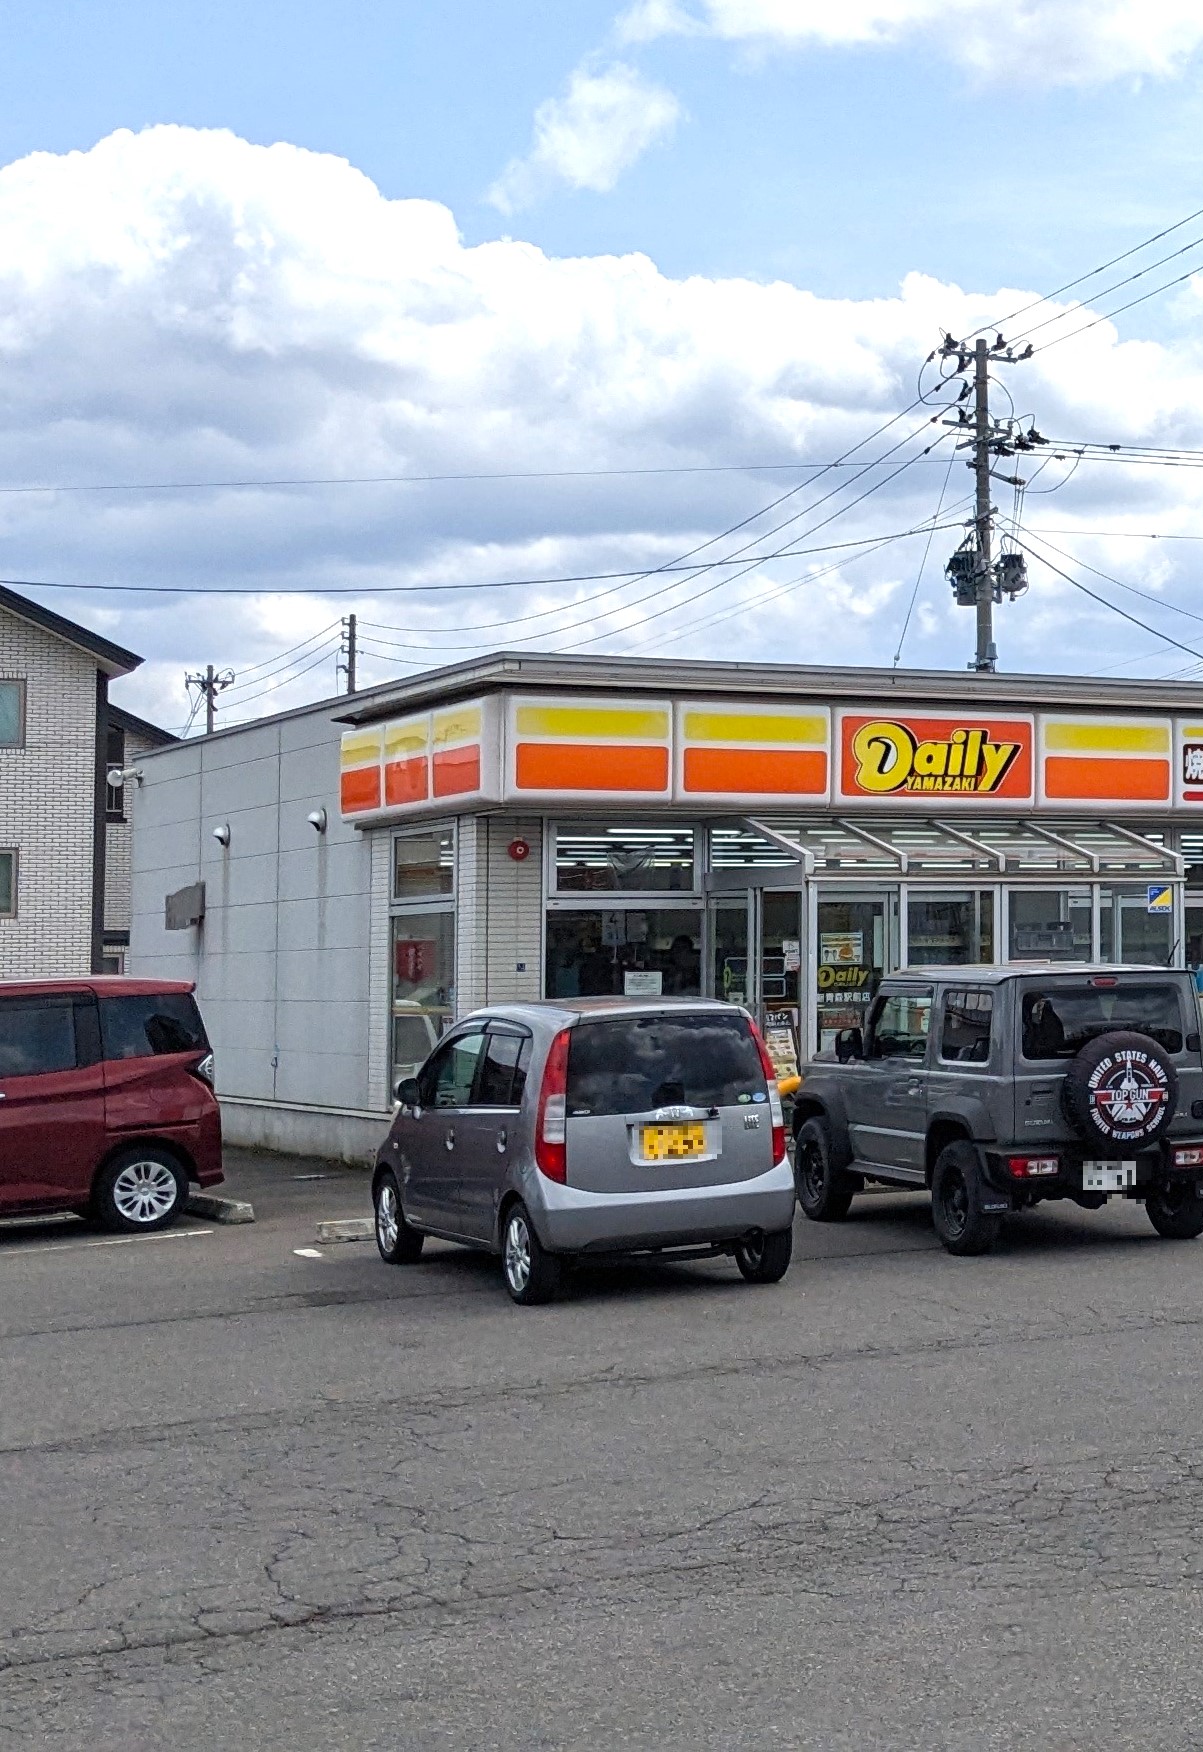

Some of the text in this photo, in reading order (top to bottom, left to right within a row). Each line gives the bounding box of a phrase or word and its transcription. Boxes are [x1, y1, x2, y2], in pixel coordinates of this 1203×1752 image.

[853, 721, 1022, 793] Daily
[906, 776, 976, 791] YAMAZAKI
[818, 966, 869, 988] Daily
[1088, 1050, 1168, 1088] UNITED STATES NAVY
[1111, 1089, 1129, 1101] TOP
[1129, 1088, 1149, 1100] GUN
[1089, 1106, 1166, 1140] FIGHTER WEAPONS SCHOOL
